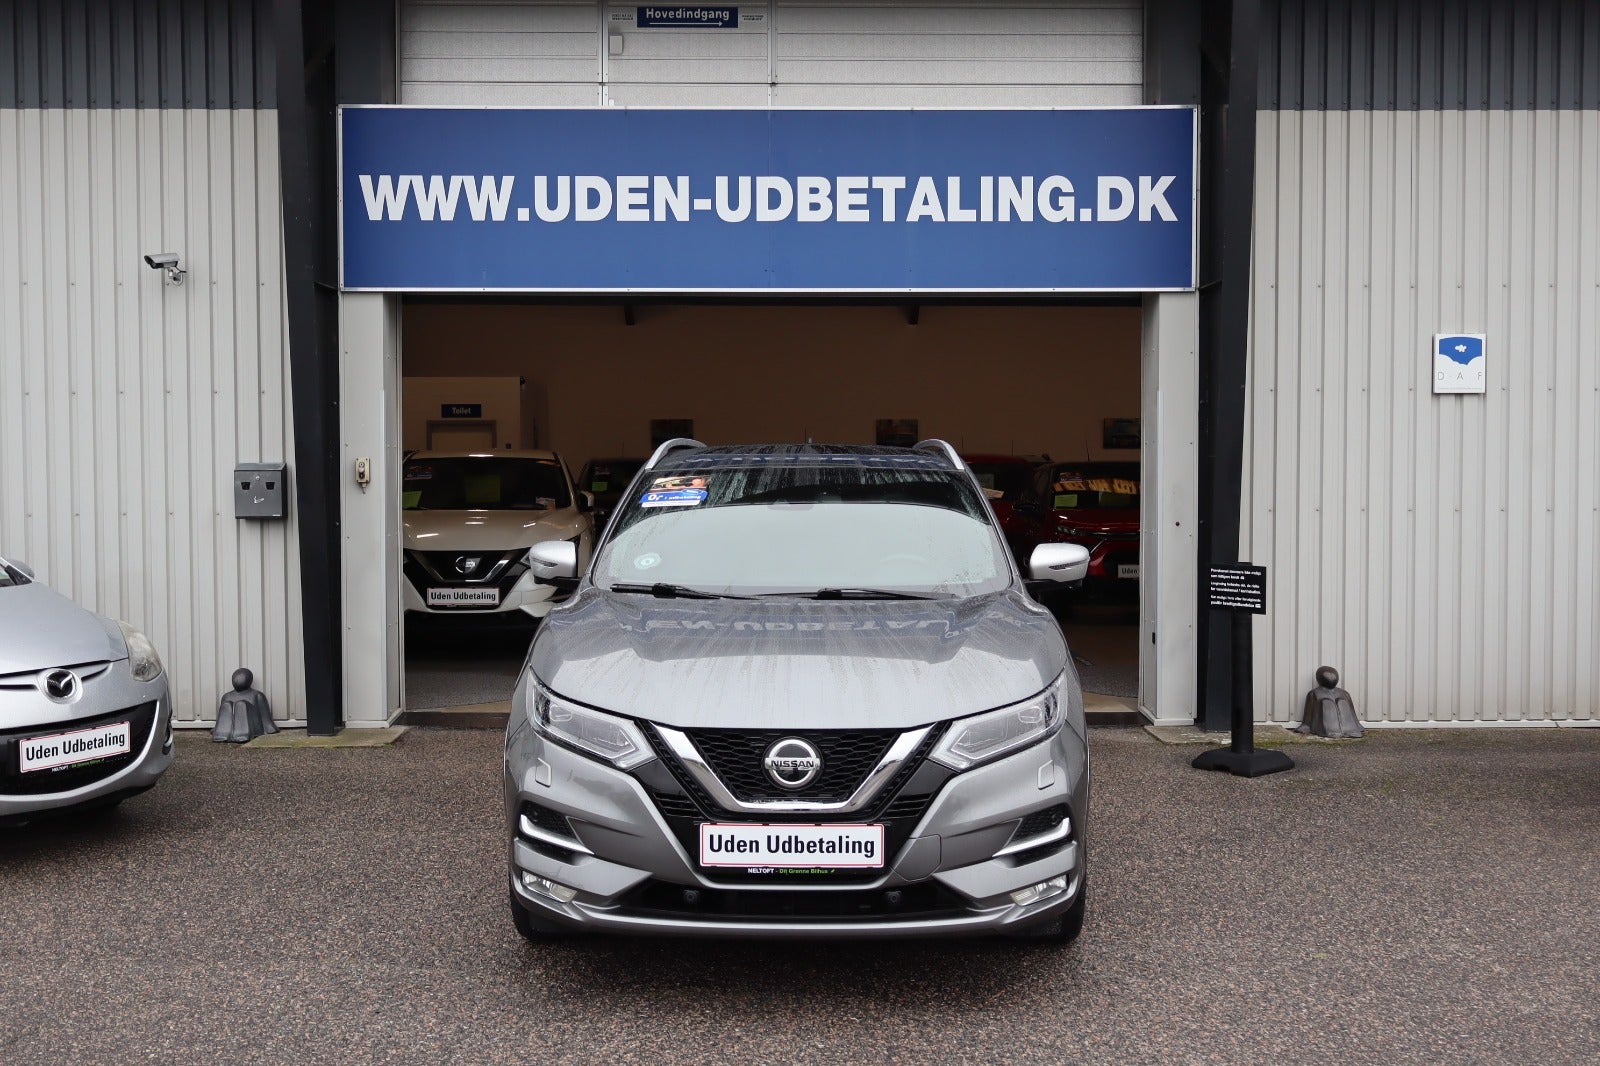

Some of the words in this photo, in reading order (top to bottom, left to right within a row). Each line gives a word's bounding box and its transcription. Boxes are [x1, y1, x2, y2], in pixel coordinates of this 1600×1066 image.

[646, 8, 730, 21] Hovedindgang
[358, 174, 1179, 223] WWW.UDEN-UDBETALING.DK
[452, 406, 472, 415] Toilet
[430, 591, 451, 600] Uden
[453, 591, 496, 602] Udbetaling
[26, 745, 59, 761] Uden
[62, 732, 125, 755] Udbetaling
[770, 760, 815, 768] NISSAN
[709, 834, 760, 853] Uden
[766, 835, 875, 859] Udbetaling
